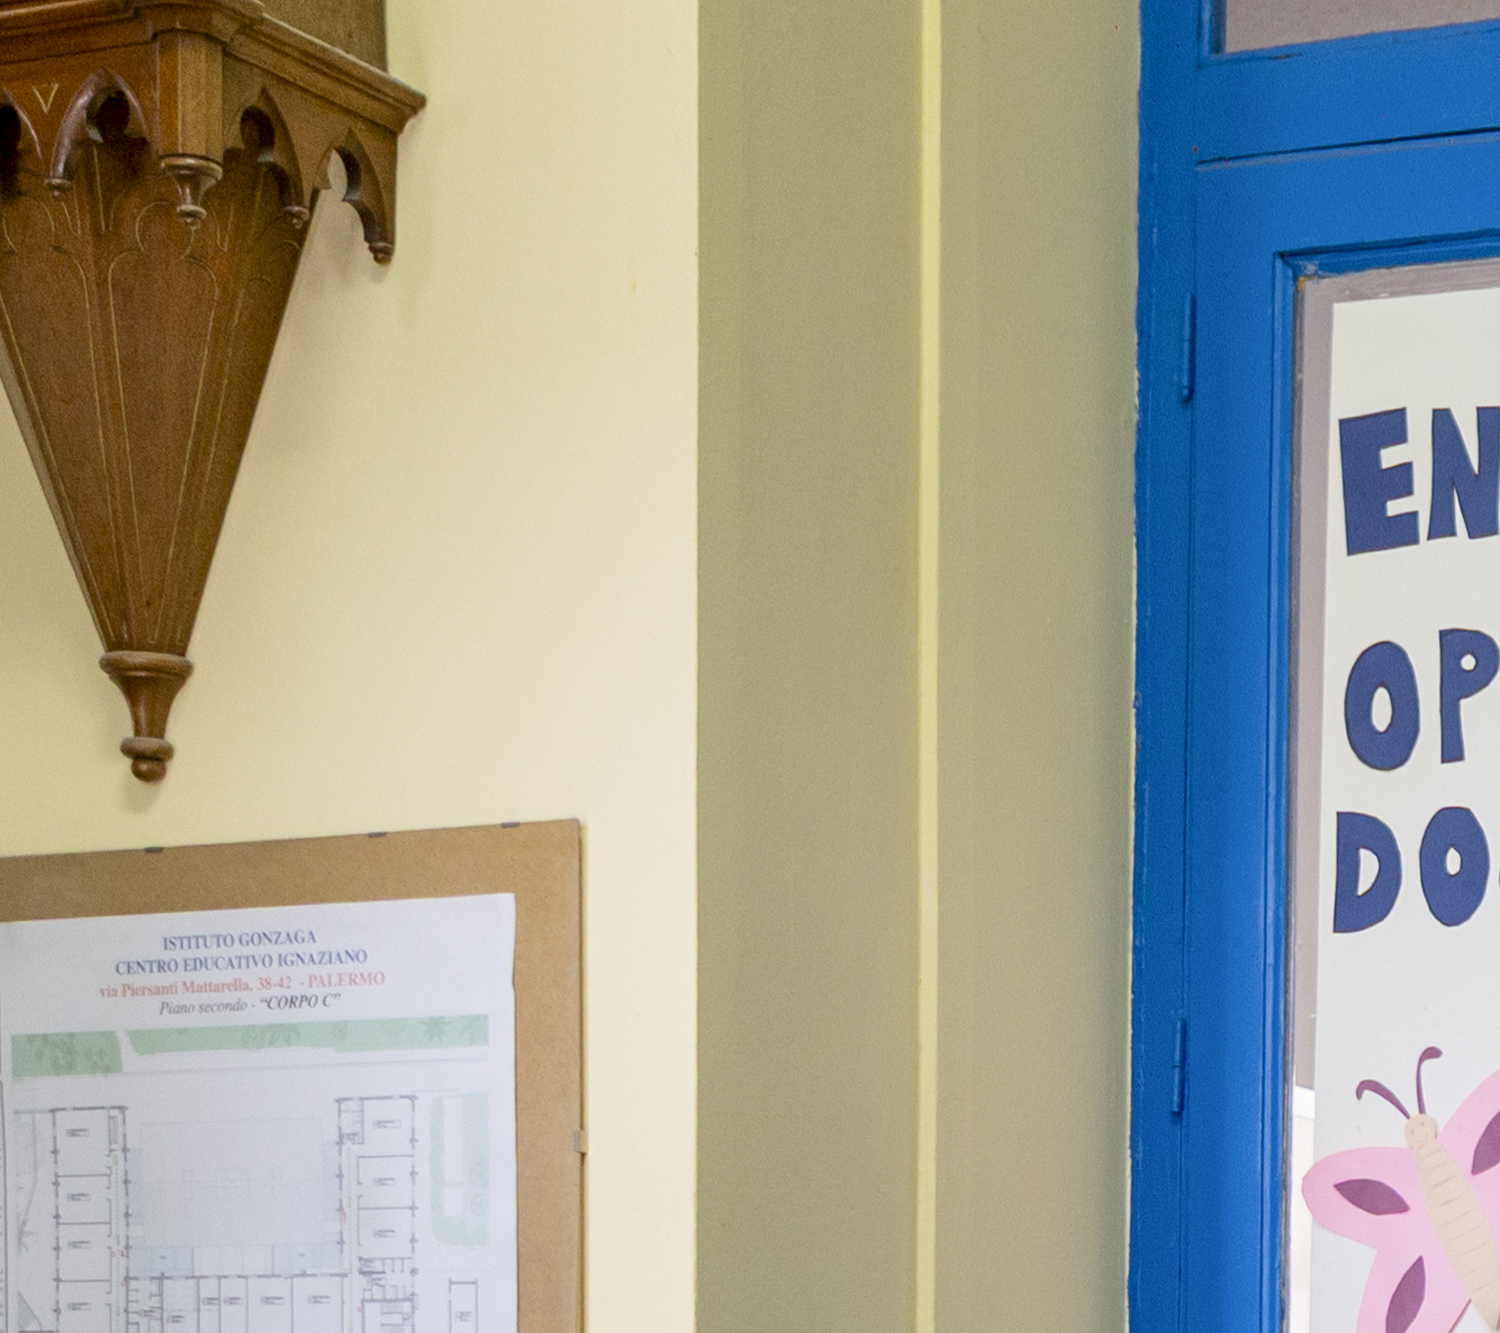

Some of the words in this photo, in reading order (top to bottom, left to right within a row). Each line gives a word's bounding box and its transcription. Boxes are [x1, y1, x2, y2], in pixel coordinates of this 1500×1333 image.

[162, 933, 235, 951] ISTITUTO
[239, 929, 317, 947] GONZAGA
[115, 957, 179, 976] CENTRO
[183, 953, 274, 973] EDUCATIVO
[278, 949, 368, 968] IGNAZIANO
[100, 985, 118, 999] via
[121, 981, 178, 998] Piersanti
[257, 975, 293, 991] 38-42
[308, 971, 386, 988] PALERMO
[160, 1001, 196, 1016] Piano
[200, 997, 248, 1014] secondo
